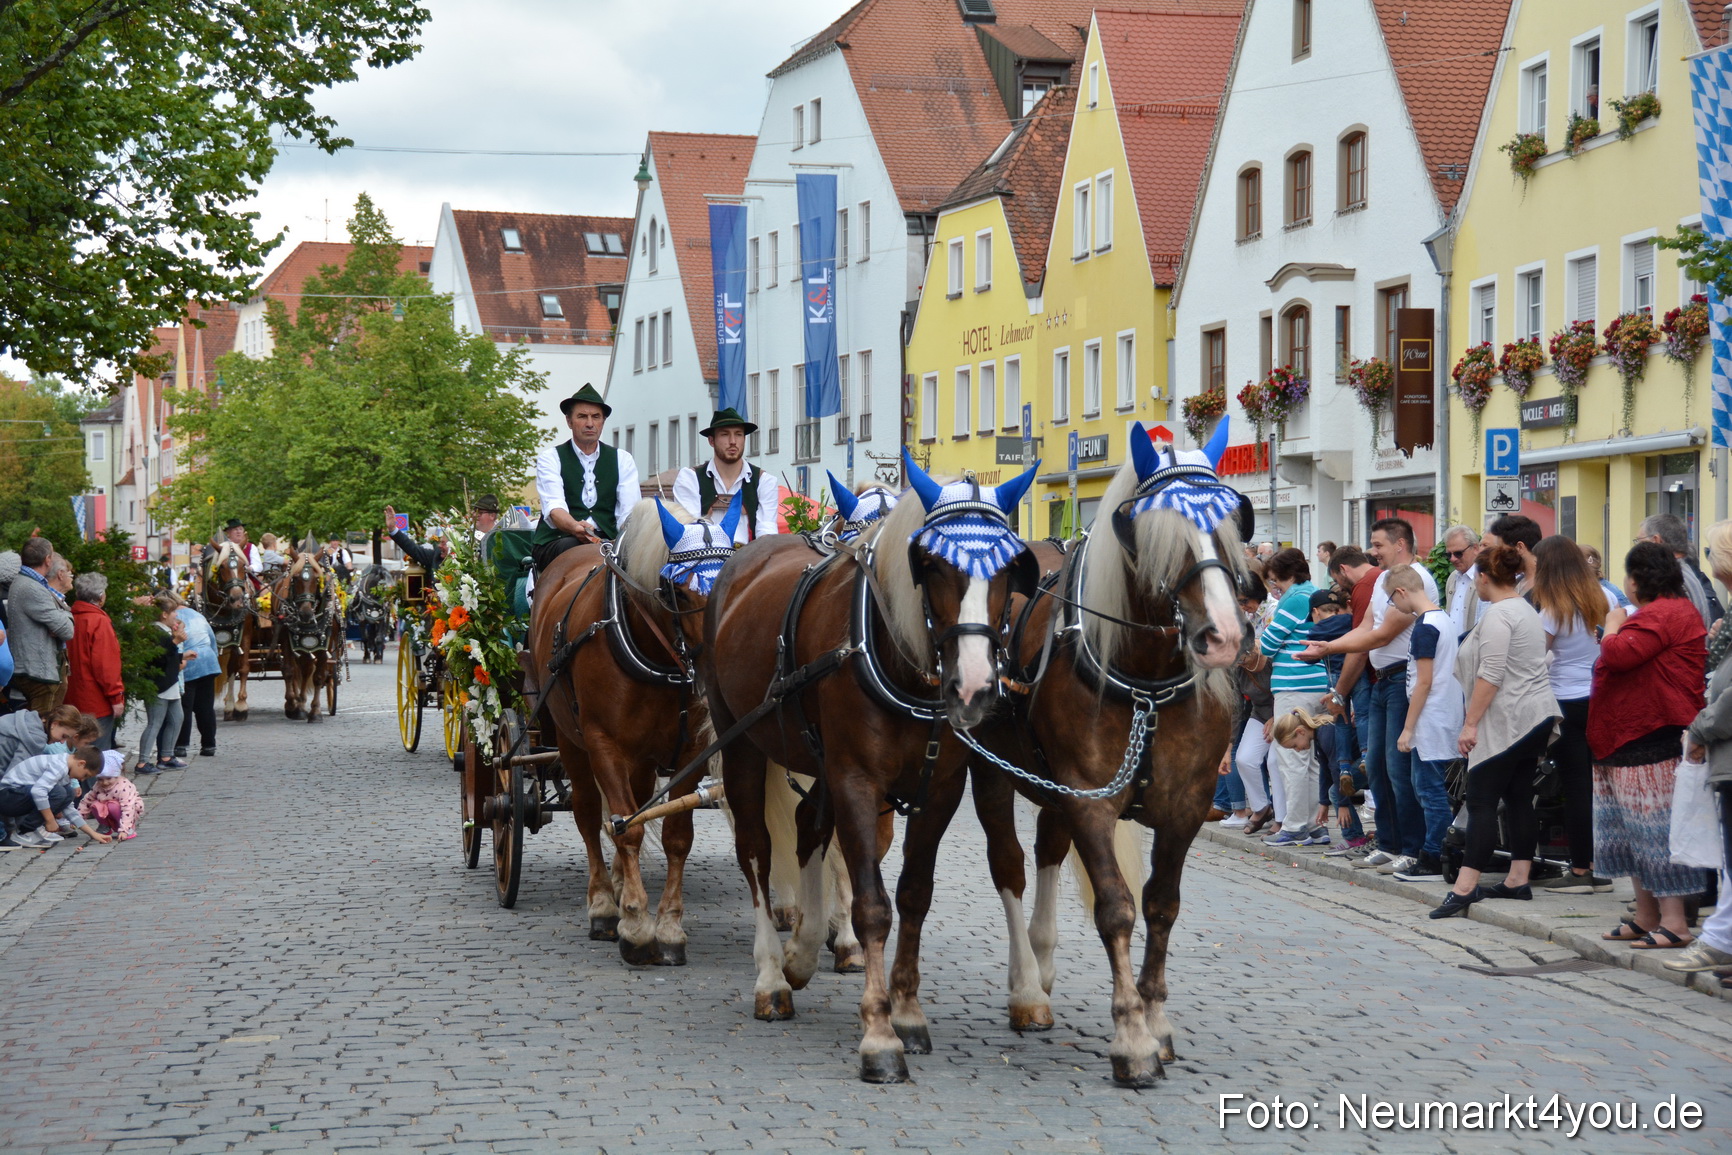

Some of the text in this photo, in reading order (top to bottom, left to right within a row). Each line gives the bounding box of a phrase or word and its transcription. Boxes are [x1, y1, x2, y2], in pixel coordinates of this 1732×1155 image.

[808, 267, 828, 323] K&L
[963, 320, 1035, 356] HOTEL Lehmeier
[1522, 406, 1543, 422] WOLLE
[1549, 403, 1567, 418] MEH
[999, 453, 1036, 461] TAIFN
[1077, 438, 1100, 457] AIFUN
[1493, 434, 1511, 470] P
[1536, 472, 1556, 488] MEHR
